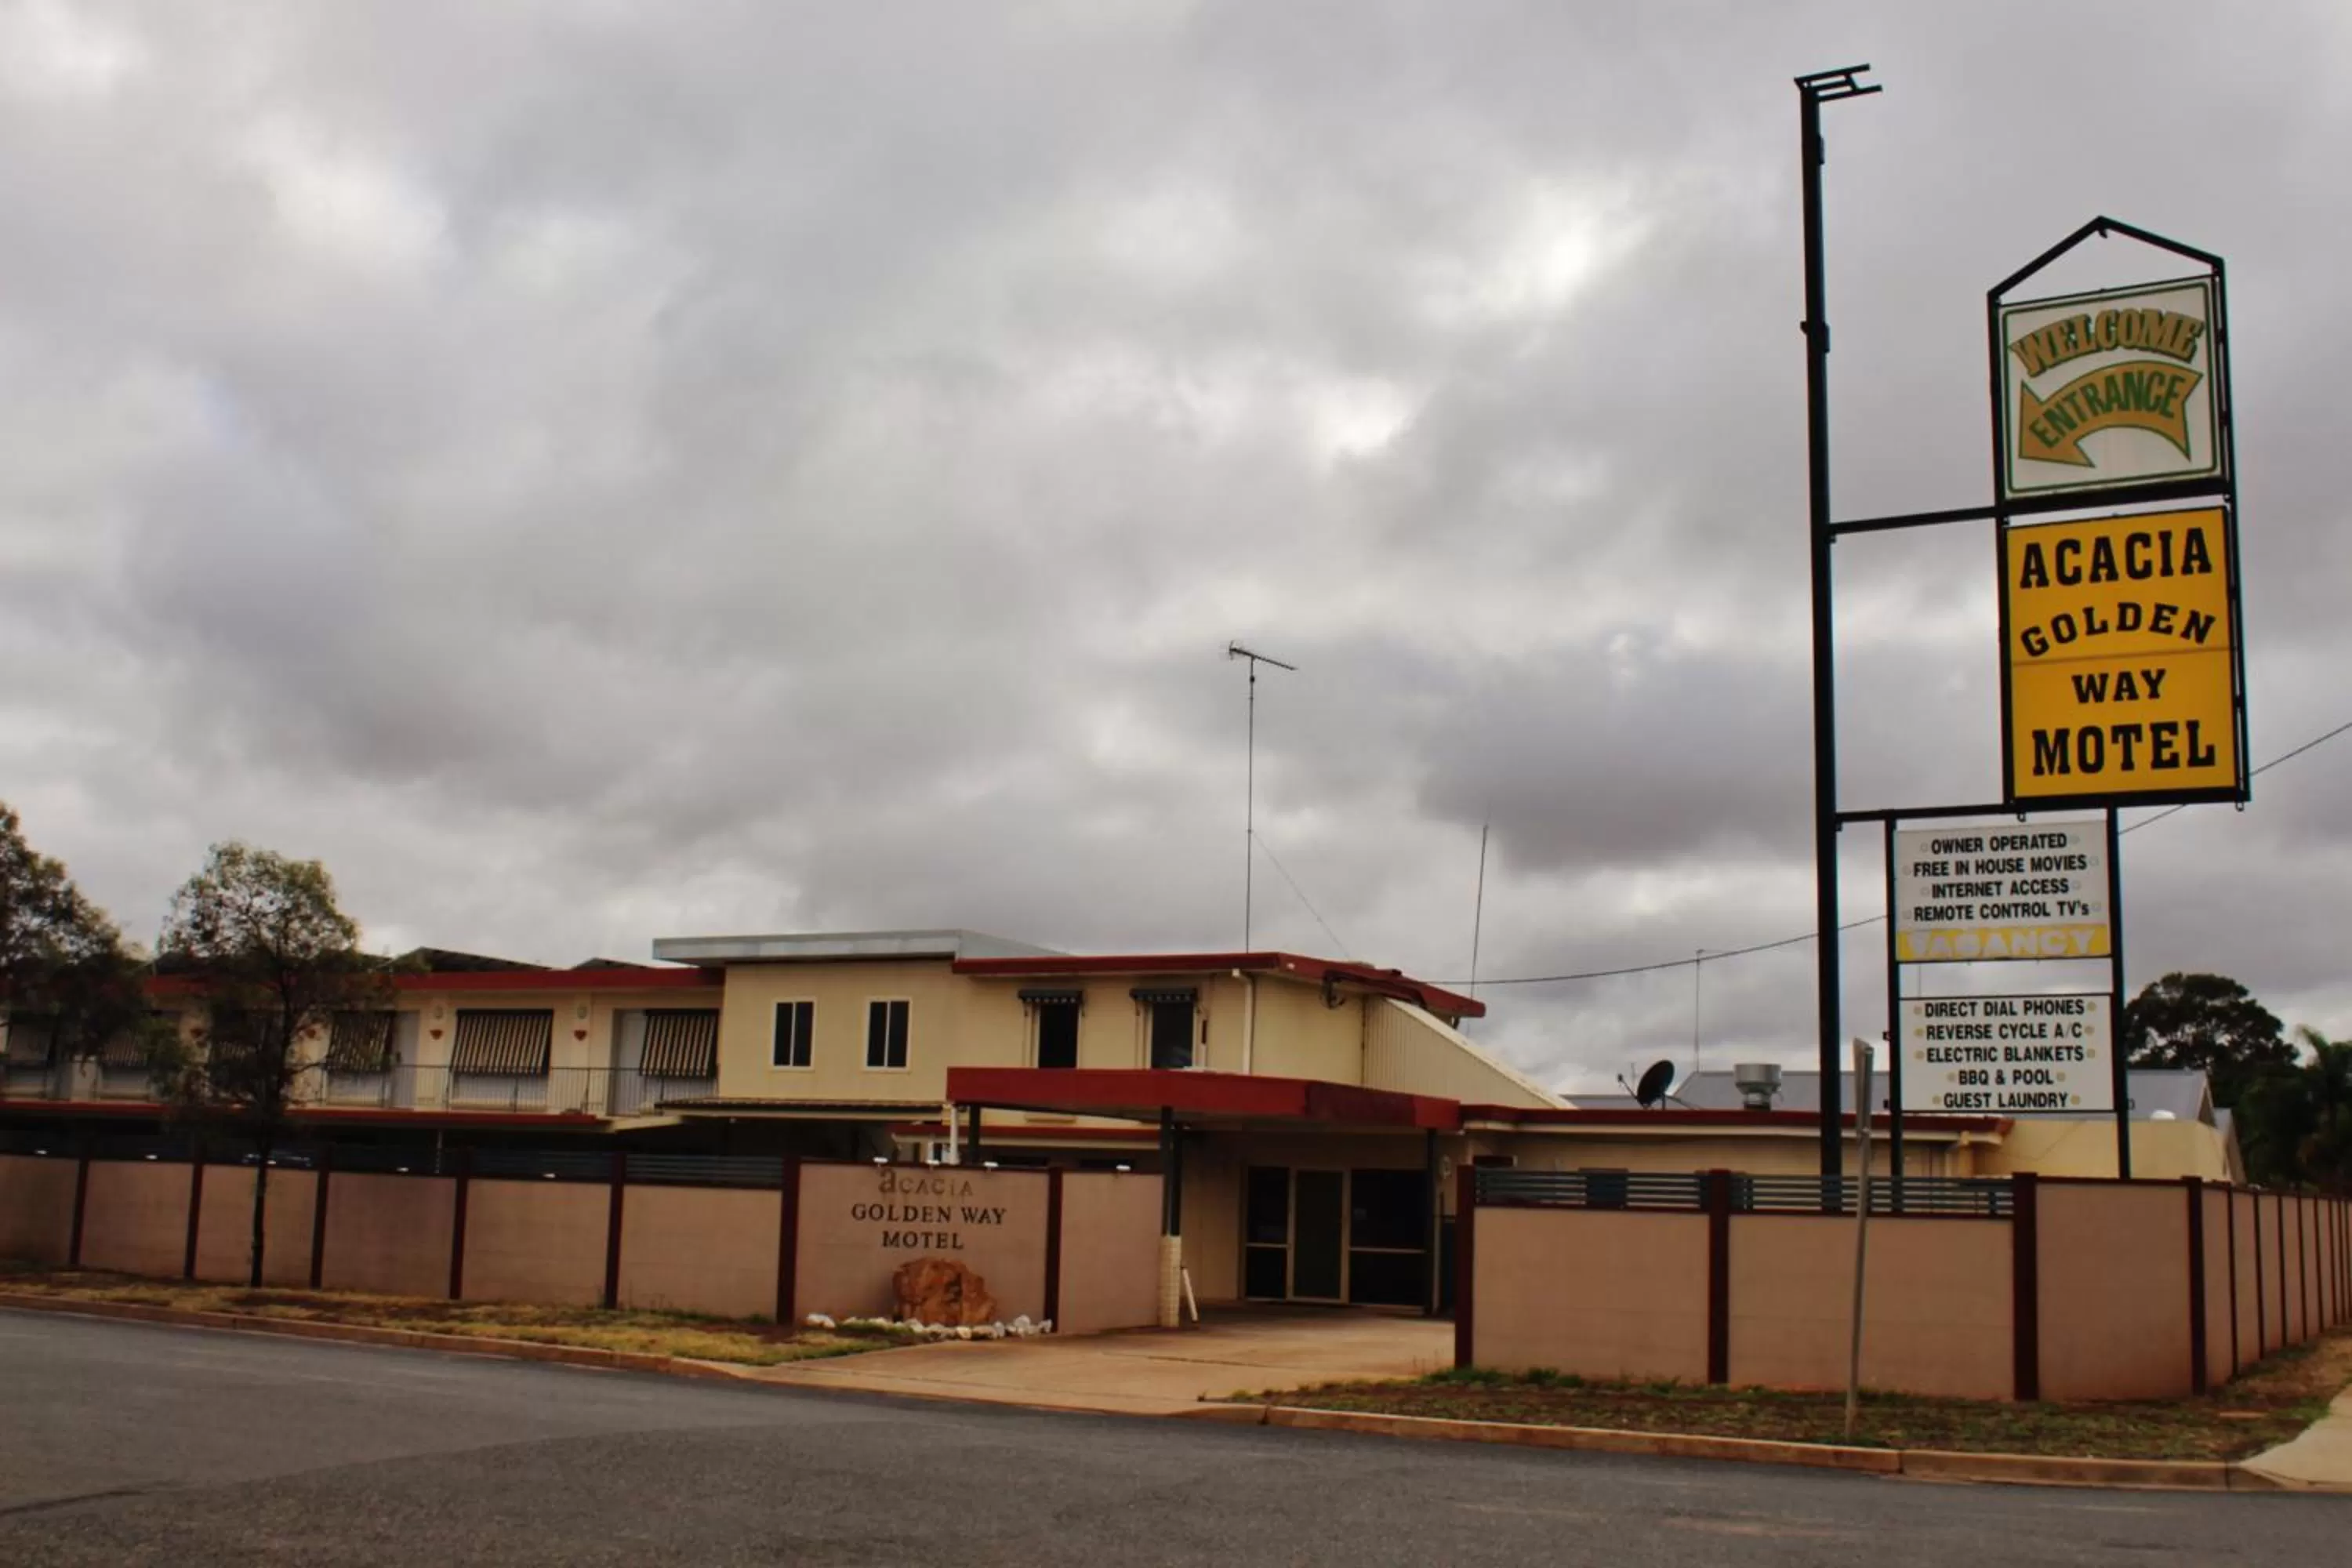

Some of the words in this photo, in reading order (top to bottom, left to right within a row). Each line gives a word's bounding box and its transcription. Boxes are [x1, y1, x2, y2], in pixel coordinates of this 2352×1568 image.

[2009, 308, 2205, 378] WELCOME
[2029, 370, 2186, 448] ENTRANCE
[2020, 527, 2212, 589] ACACIA
[2020, 602, 2216, 657] GOLDEN
[2071, 669, 2166, 703] WAY
[2031, 720, 2216, 776] MOTEL
[1931, 837, 1984, 855] OWNER
[1989, 833, 2067, 851] OPERATED
[1913, 862, 1949, 877] FREE
[1955, 861, 1969, 876] IN
[1976, 858, 2024, 874] HOUSE
[2031, 855, 2087, 872] MOVIES
[1932, 881, 2002, 898] INTERNET
[2010, 878, 2069, 895] ACCESS
[1914, 904, 1974, 921] REMOTE
[1980, 901, 2051, 919] CONTROL
[2057, 900, 2089, 917] TV's
[1925, 1002, 1977, 1018] DIRECT
[1984, 1000, 2018, 1016] DIAL
[2024, 999, 2085, 1015] PHONES
[1926, 1024, 1992, 1040] REVERSE
[1998, 1023, 2047, 1040] CYCLE
[2054, 1022, 2083, 1039] A/C
[1926, 1047, 1998, 1062] ELECTRIC
[2004, 1046, 2084, 1062] BLANKETS
[1958, 1070, 1989, 1085] BBQ
[1994, 1069, 2006, 1084] &
[2013, 1069, 2054, 1084] POOL
[1944, 1093, 1992, 1108] GUEST
[1997, 1092, 2068, 1108] LAUNDRY
[851, 1203, 951, 1223] GOLDEN
[960, 1207, 1007, 1225] WAY
[881, 1230, 964, 1250] MOTEL
